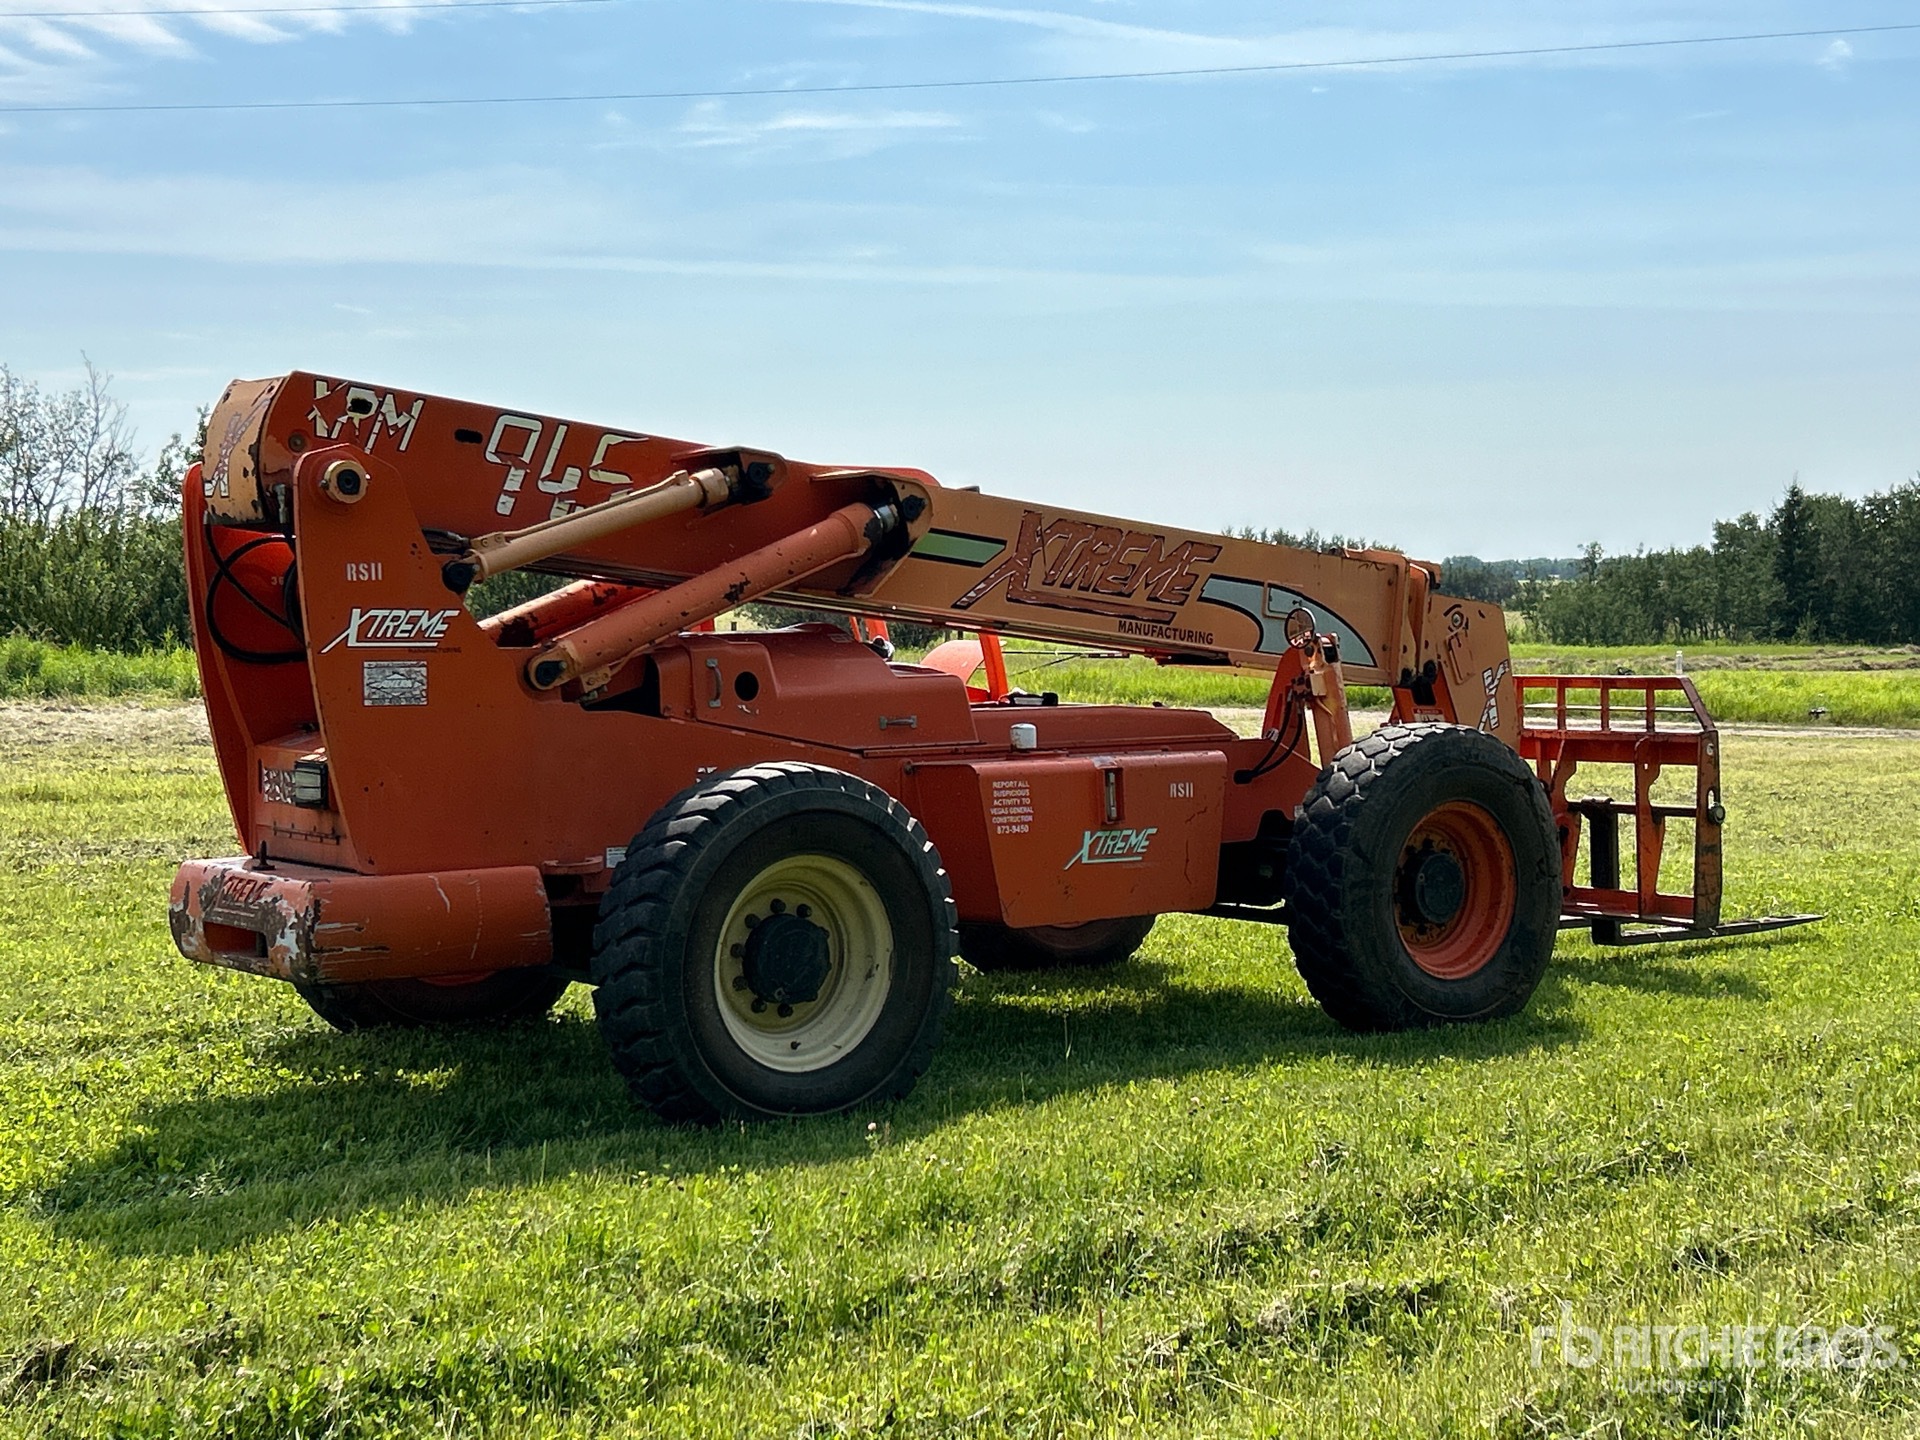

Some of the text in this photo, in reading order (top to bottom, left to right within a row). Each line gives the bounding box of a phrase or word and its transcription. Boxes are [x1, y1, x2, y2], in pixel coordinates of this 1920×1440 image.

[951, 509, 1222, 624] XTREME
[320, 608, 461, 655] XTREME
[1118, 620, 1214, 645] MANUFACTURING
[992, 780, 1031, 789] REPORT ALL
[993, 797, 1031, 806] ACTIVITY TO
[1063, 827, 1158, 871] XTREME
